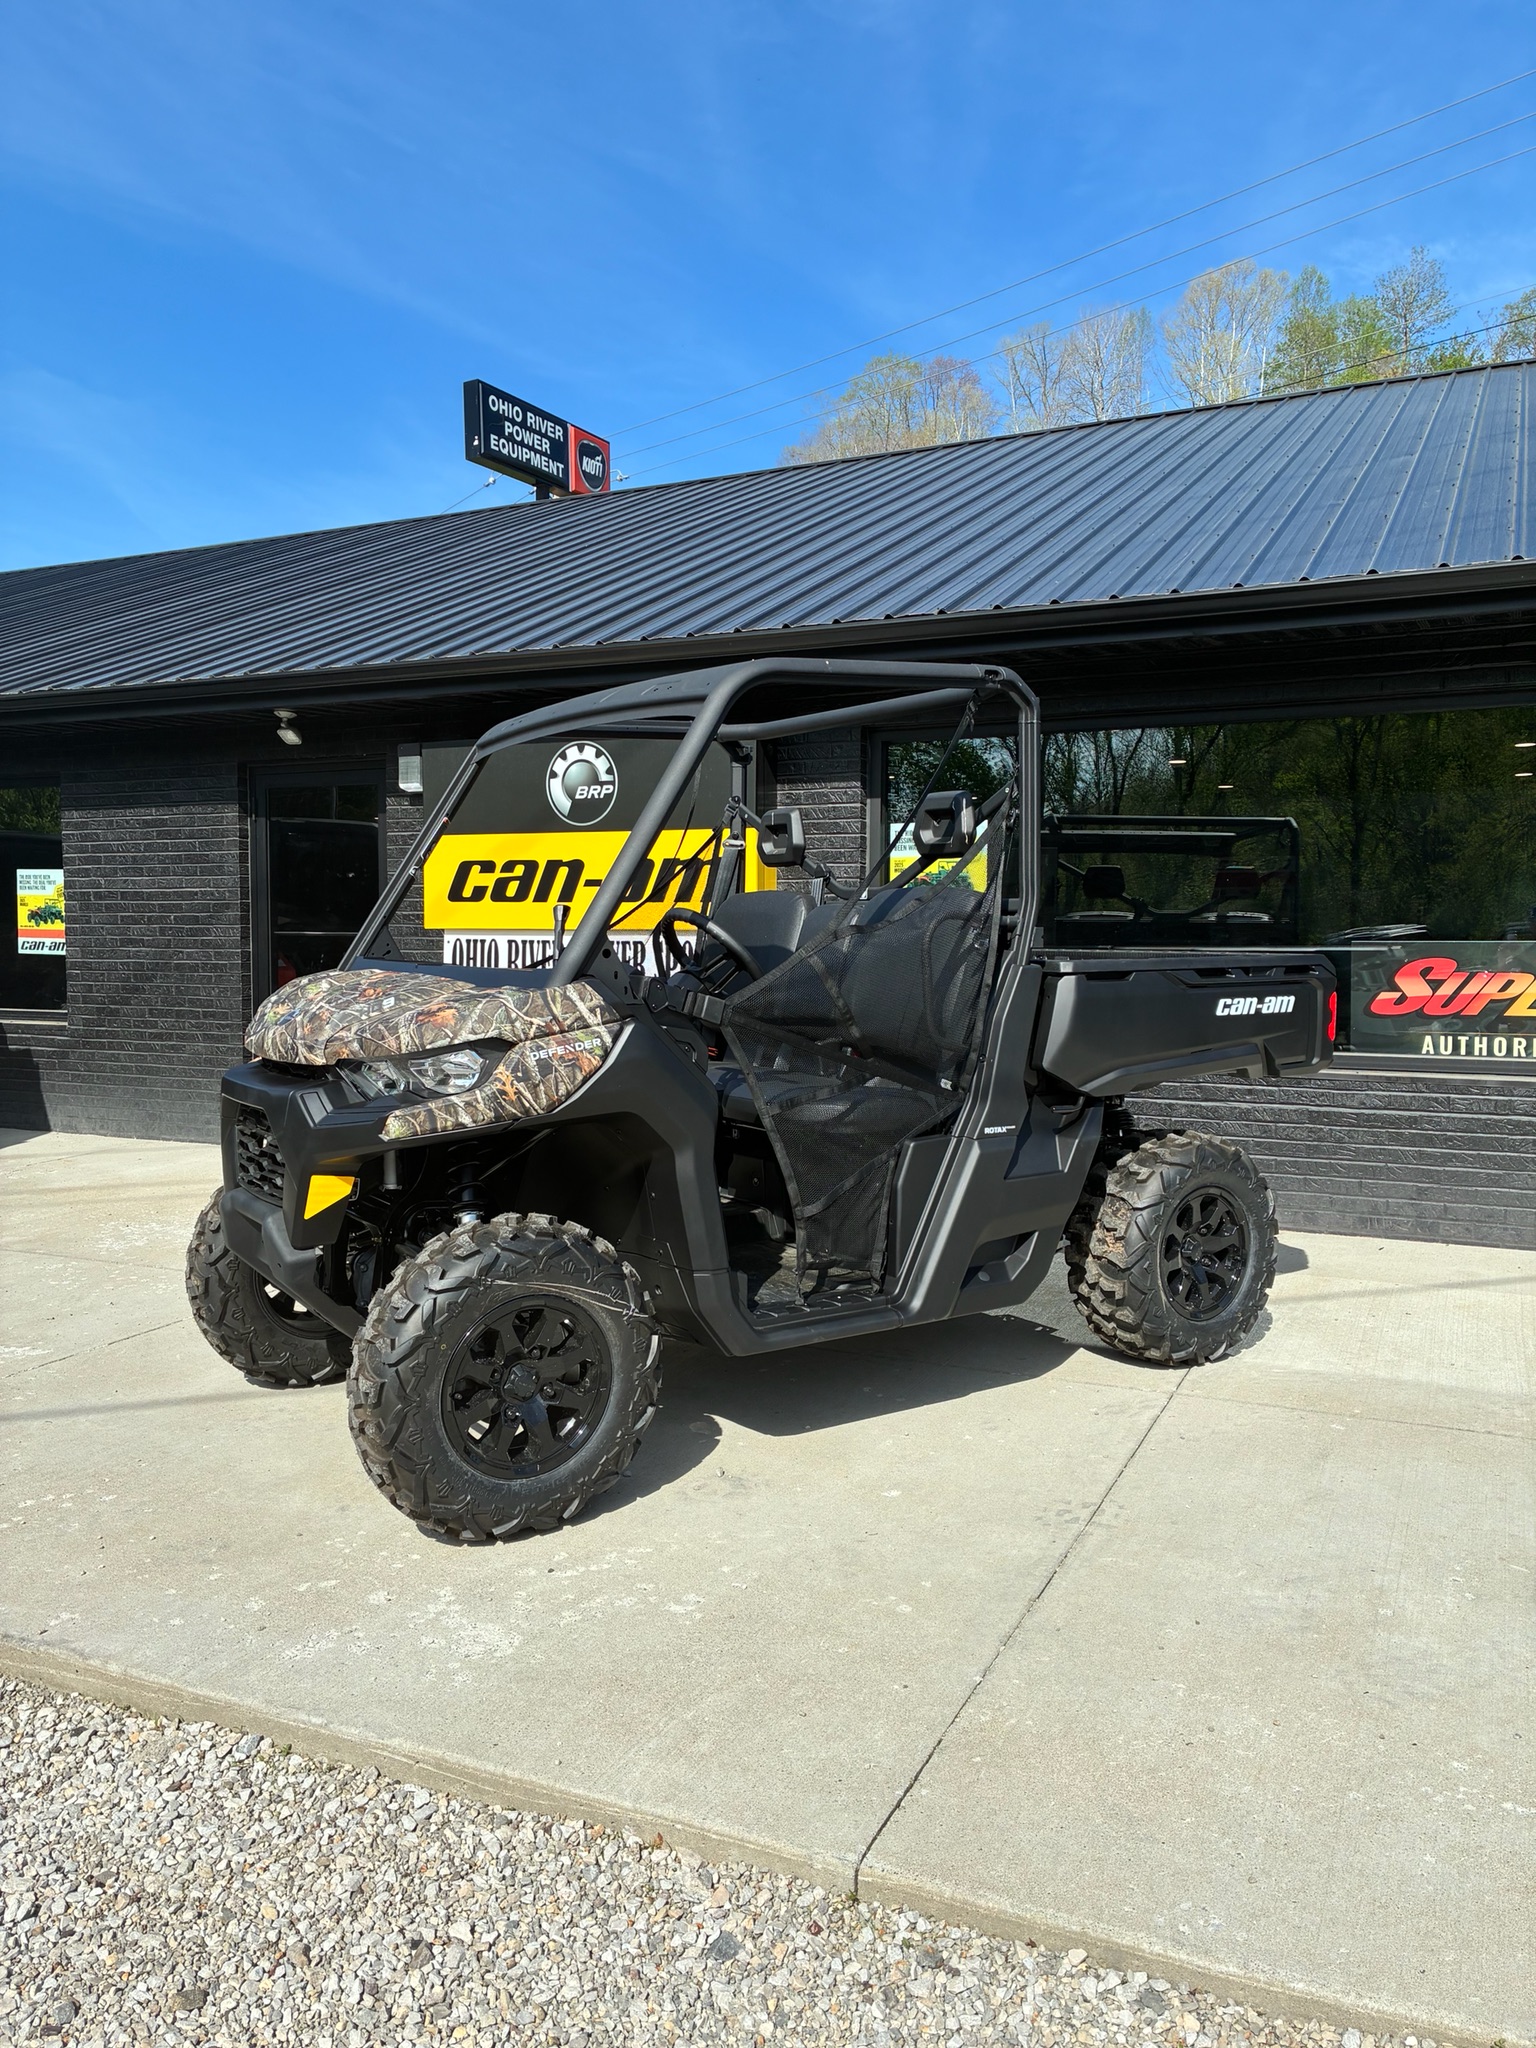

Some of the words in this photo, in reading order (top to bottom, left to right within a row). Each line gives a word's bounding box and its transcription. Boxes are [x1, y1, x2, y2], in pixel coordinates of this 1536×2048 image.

[488, 394, 523, 423] OHIO
[526, 411, 564, 442] RIVER
[504, 420, 550, 455] POWER
[490, 433, 565, 478] EQUIPMENT
[574, 784, 614, 799] BRP
[451, 938, 500, 968] OHIO
[506, 939, 557, 969] RIVE
[1215, 995, 1296, 1016] can-am
[529, 1038, 602, 1062] DEFENDER
[984, 1126, 1007, 1135] ROTAX
